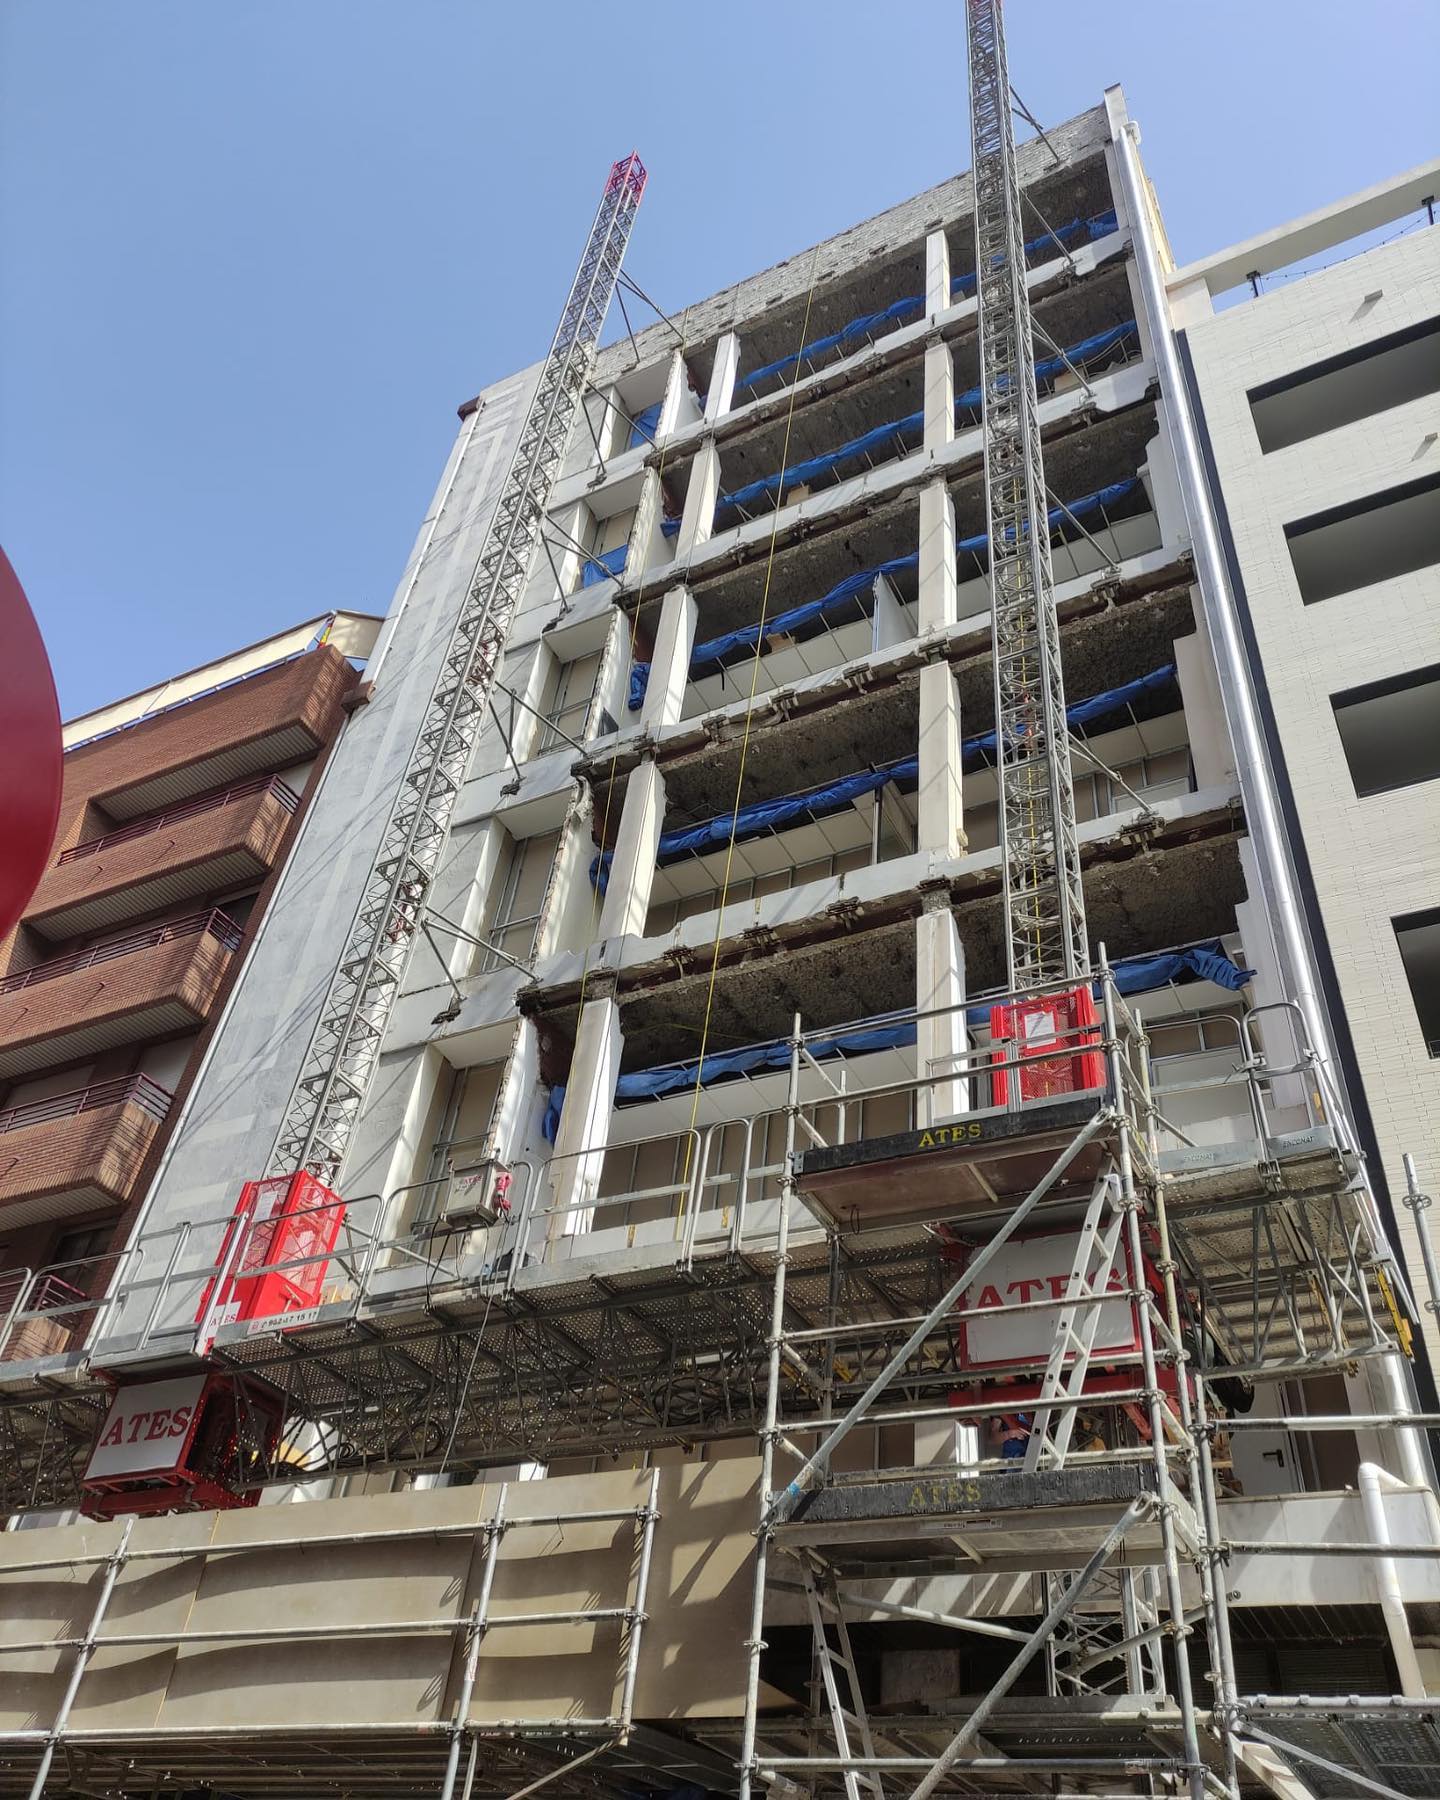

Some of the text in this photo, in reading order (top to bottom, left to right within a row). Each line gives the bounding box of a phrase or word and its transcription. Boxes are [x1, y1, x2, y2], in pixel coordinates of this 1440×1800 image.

[918, 1123, 982, 1148] ATES
[99, 1406, 193, 1448] ATES
[908, 1482, 981, 1508] ATES
